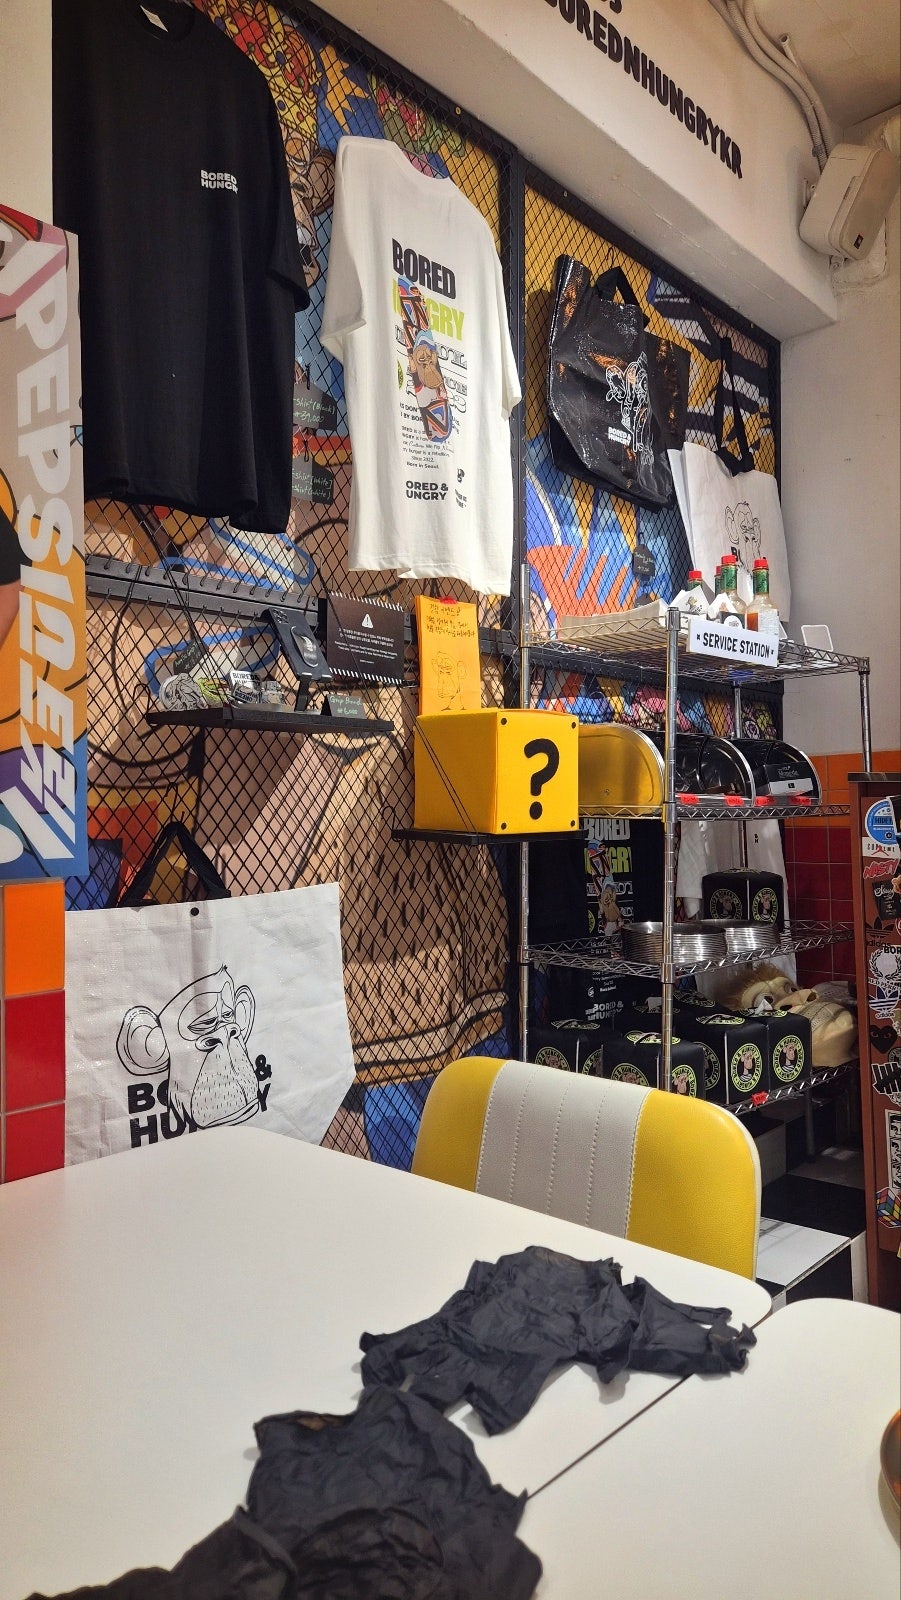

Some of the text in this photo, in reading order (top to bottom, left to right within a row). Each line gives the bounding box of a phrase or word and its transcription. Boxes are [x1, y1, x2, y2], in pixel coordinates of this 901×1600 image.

[544, 0, 743, 179] OREDNHUNGRYKR
[200, 169, 238, 185] BORED
[391, 237, 457, 300] BORED
[440, 482, 449, 492] &
[702, 632, 770, 659] SERVICE STATION
[254, 1053, 273, 1081] &
